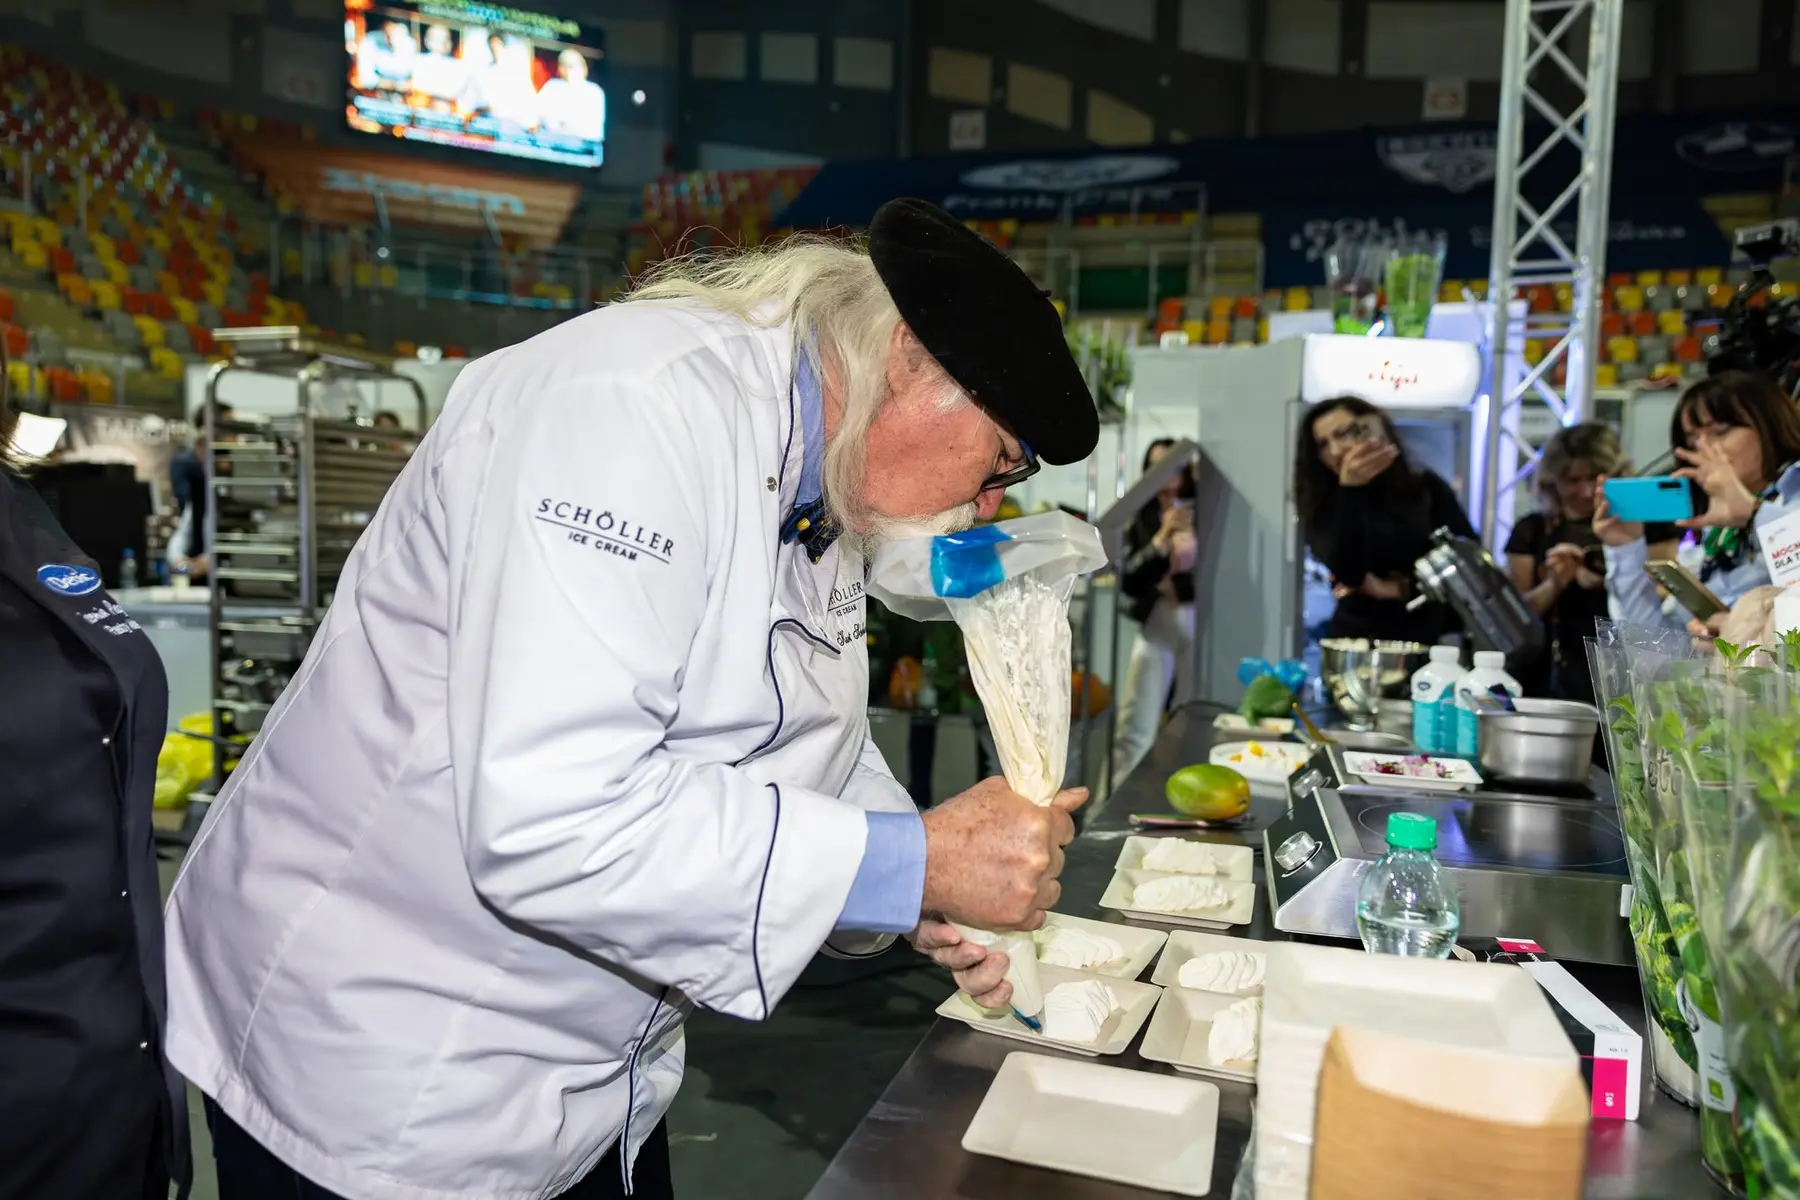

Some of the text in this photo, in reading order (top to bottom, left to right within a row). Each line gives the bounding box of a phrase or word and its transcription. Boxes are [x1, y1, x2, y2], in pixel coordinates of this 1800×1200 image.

[538, 498, 674, 556] SCHÖLLER
[568, 532, 638, 561] ICE CREAM
